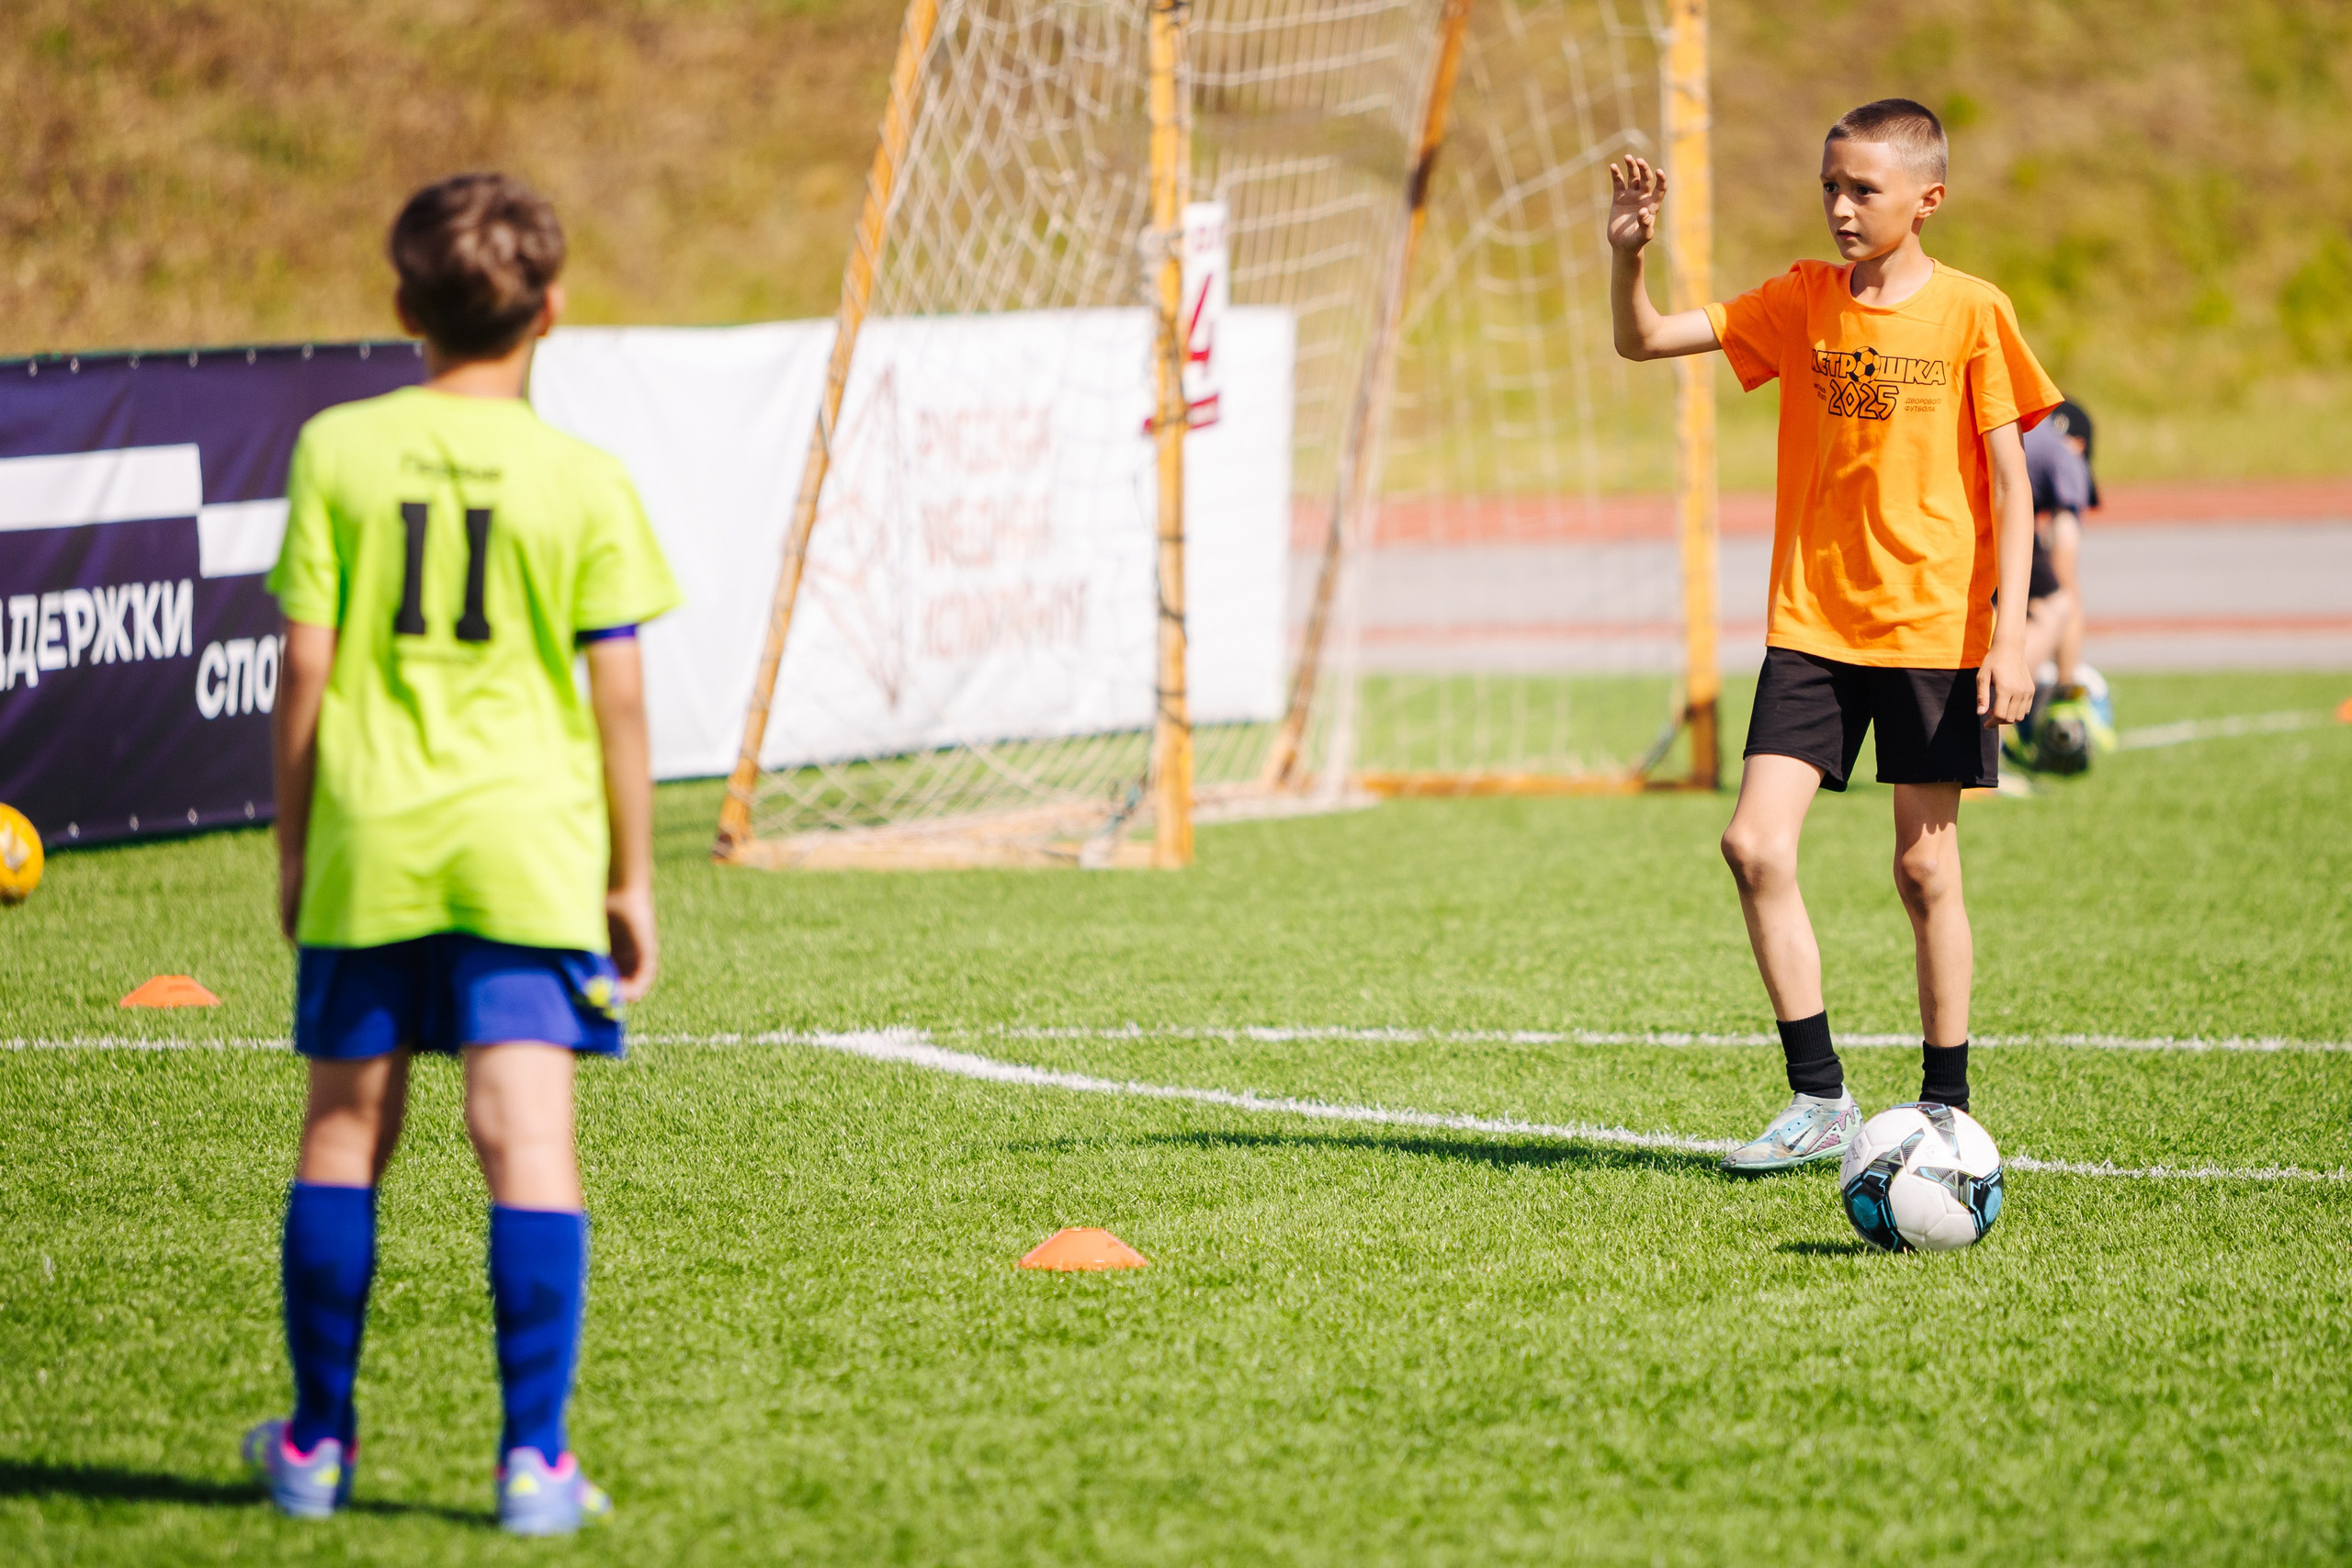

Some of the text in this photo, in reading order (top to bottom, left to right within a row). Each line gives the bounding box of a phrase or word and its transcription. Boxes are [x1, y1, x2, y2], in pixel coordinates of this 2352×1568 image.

[1828, 379, 1899, 421] 2025
[394, 502, 491, 640] 11
[0, 578, 194, 691] ДЕРЖКИ
